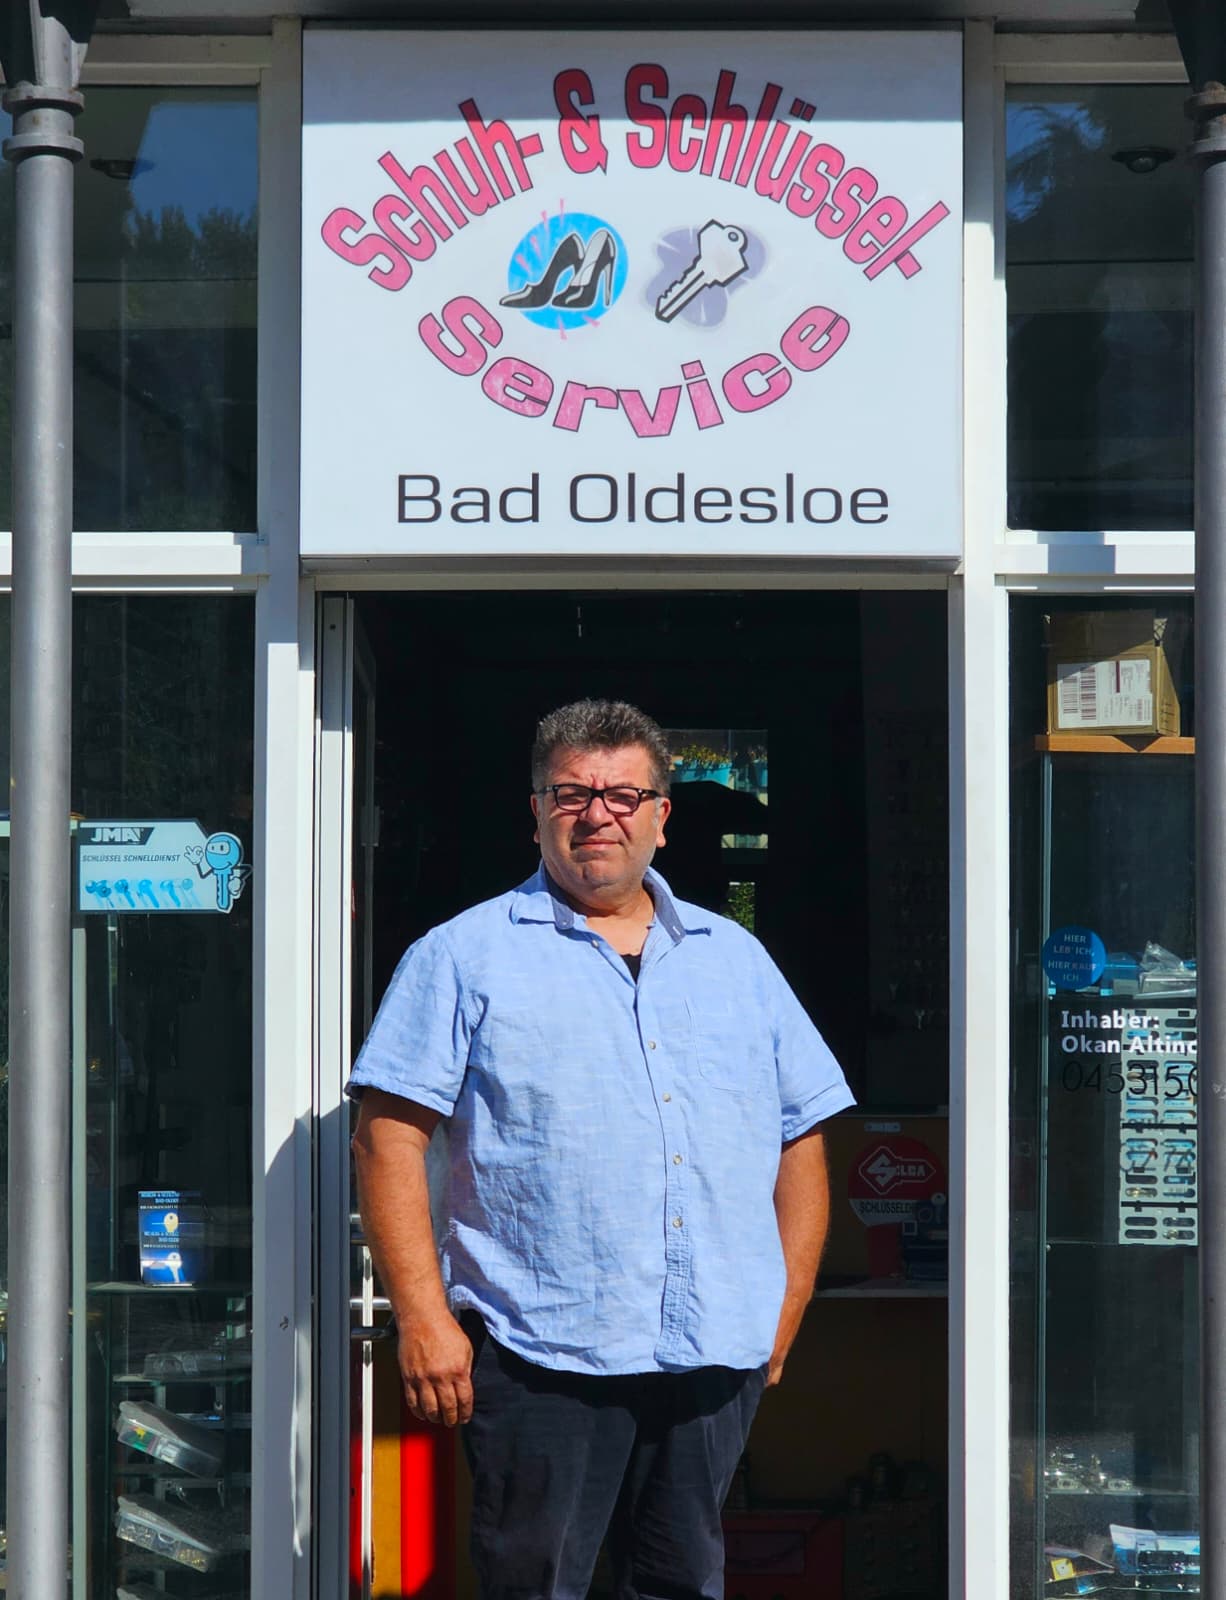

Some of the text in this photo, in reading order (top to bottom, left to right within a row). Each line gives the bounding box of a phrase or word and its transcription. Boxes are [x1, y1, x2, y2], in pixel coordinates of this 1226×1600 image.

[321, 63, 951, 291] Schuh- & Schlüssel-
[418, 296, 851, 438] Service
[398, 472, 889, 524] Bad Oldesloe
[91, 827, 141, 842] JMA
[123, 854, 181, 863] SCHNELLDIENST
[1064, 934, 1086, 944] HIER
[1048, 960, 1070, 969] HIER
[1061, 1009, 1159, 1029] Inhaber:
[1061, 1034, 1120, 1053] Okan
